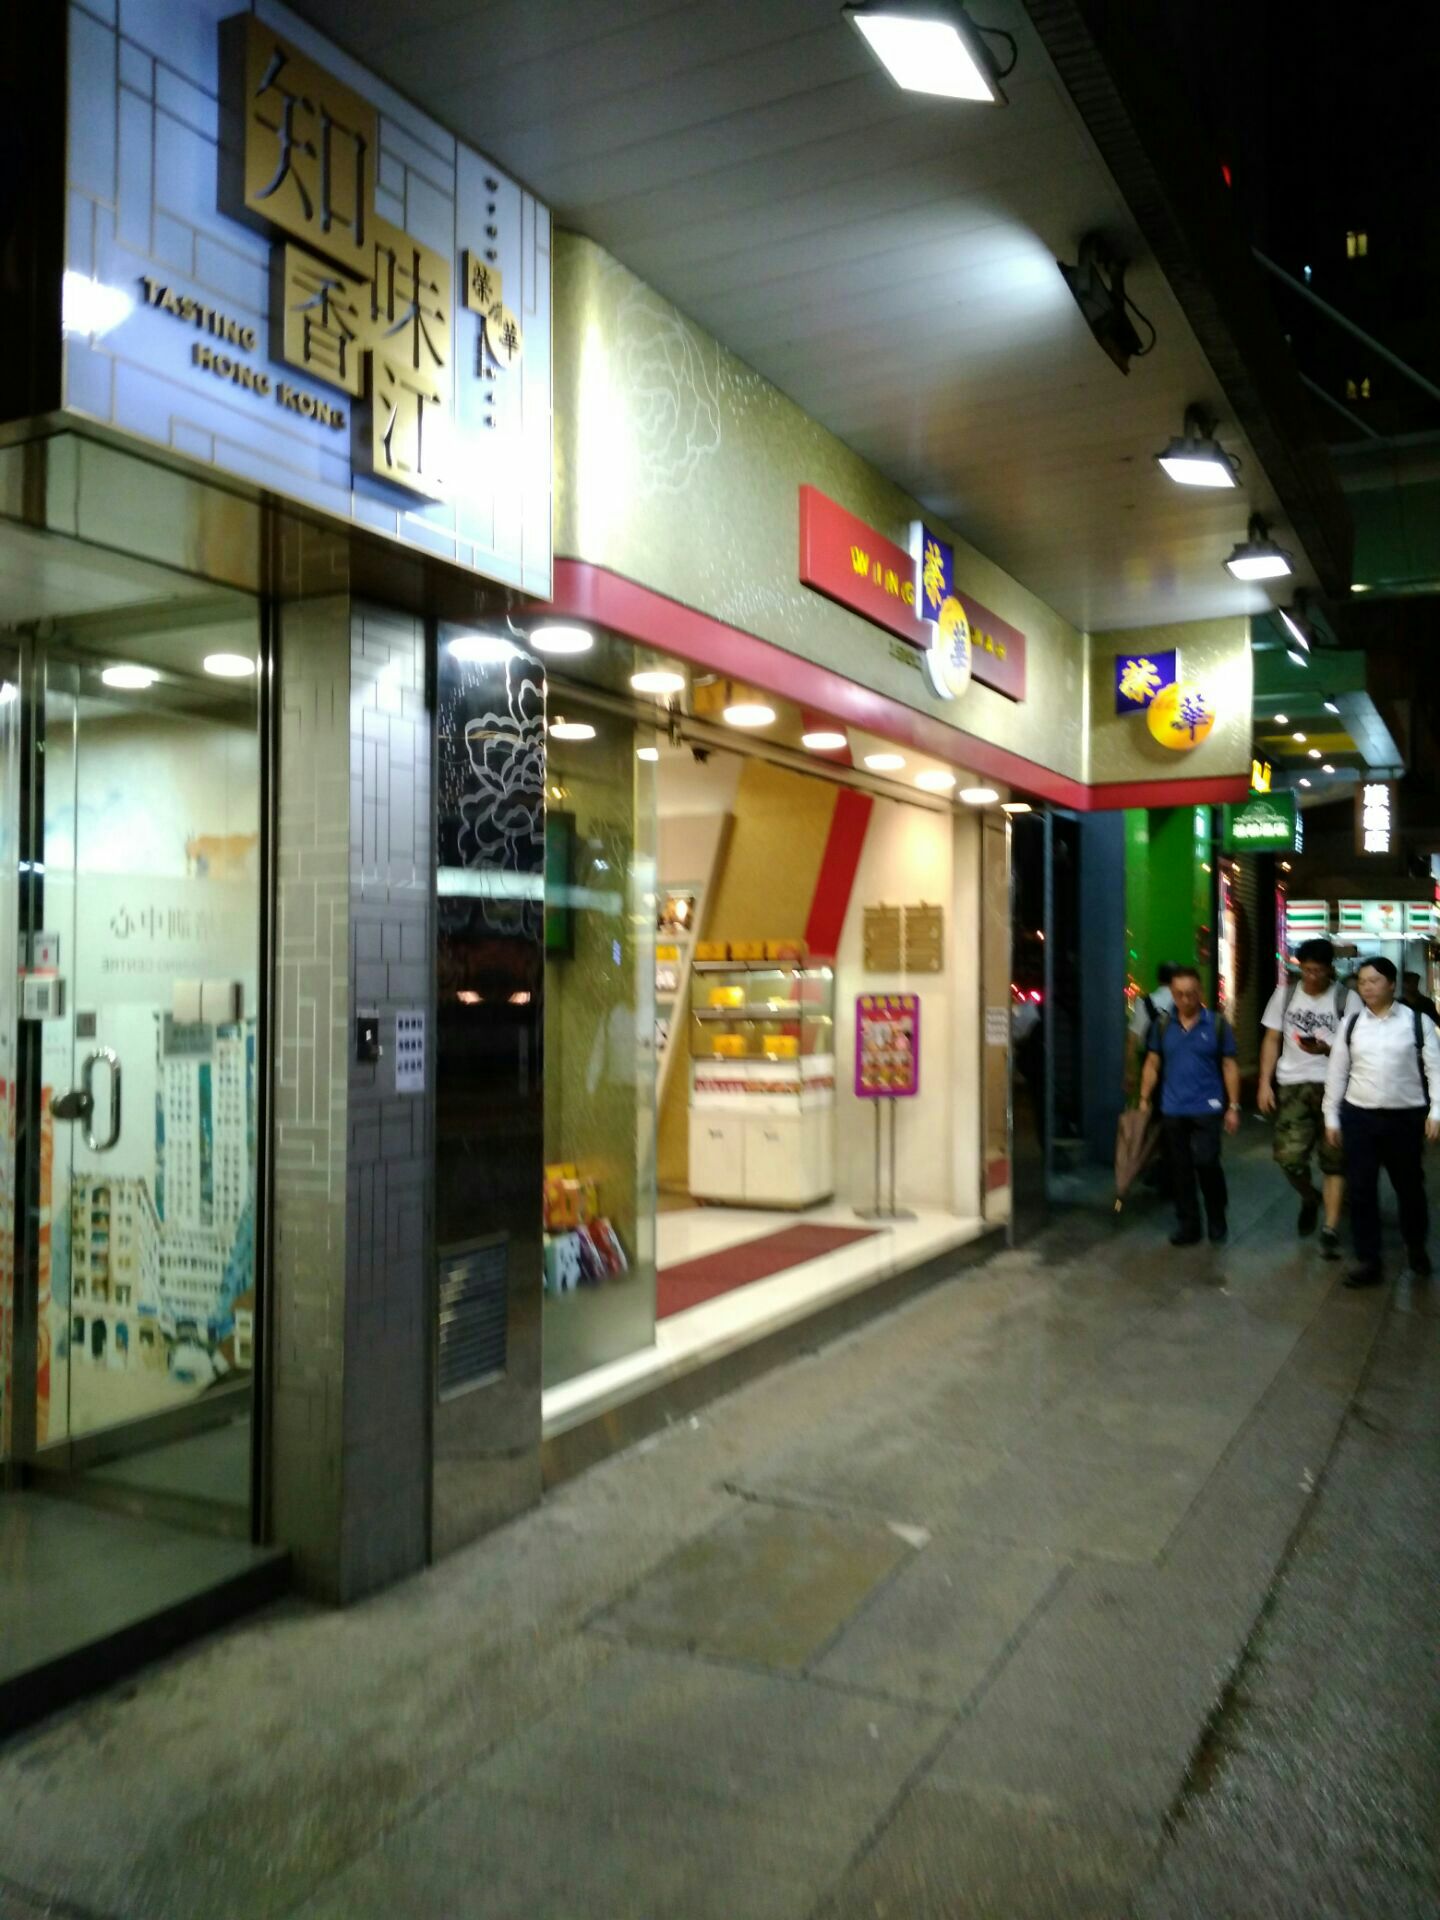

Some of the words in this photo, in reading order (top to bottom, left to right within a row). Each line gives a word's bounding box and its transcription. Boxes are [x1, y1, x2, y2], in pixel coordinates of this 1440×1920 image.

[138, 275, 257, 352] TASTING
[192, 341, 272, 396] HONG
[276, 382, 346, 430] KONG
[850, 545, 915, 606] WING
